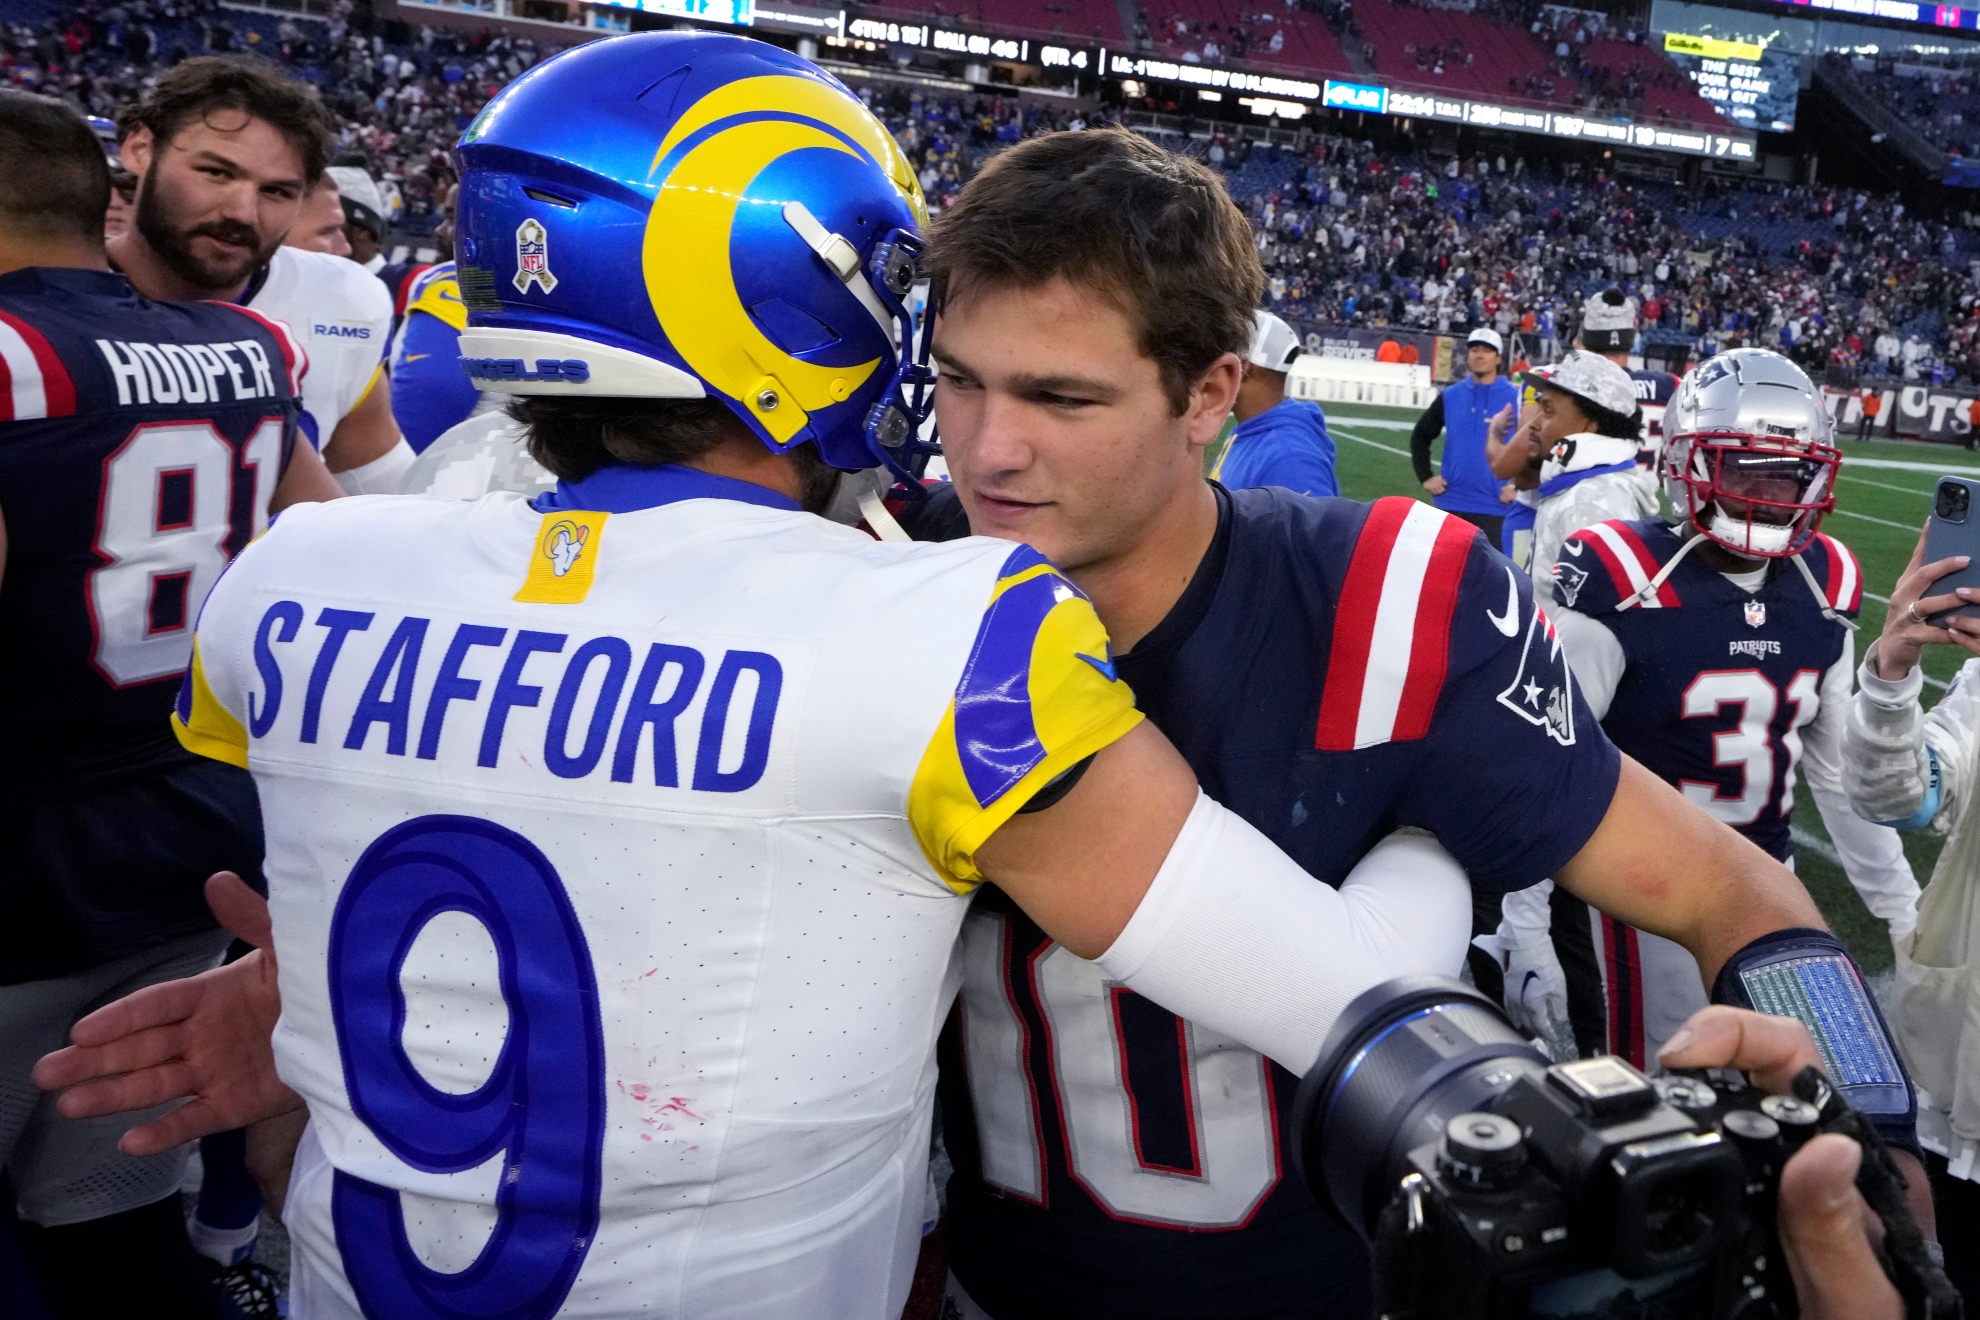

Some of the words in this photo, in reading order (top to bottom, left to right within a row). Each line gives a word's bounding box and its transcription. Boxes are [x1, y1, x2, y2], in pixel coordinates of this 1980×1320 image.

[1701, 59, 1727, 74] THE
[1729, 63, 1761, 78] BEST
[1699, 86, 1729, 101] CAN
[1731, 90, 1758, 104] GET
[1730, 77, 1770, 93] GAME
[522, 255, 543, 269] NFL
[313, 323, 371, 340] RAMS
[1322, 346, 1375, 361] SERVICE
[95, 339, 276, 406] HOOPER
[1634, 379, 1657, 400] RY
[84, 416, 286, 690] 81
[1729, 640, 1781, 656] PATRIOTS
[248, 600, 784, 792] STAFFORD
[1680, 667, 1820, 827] 31
[327, 814, 607, 1320] 9
[955, 908, 1283, 1234] 10
